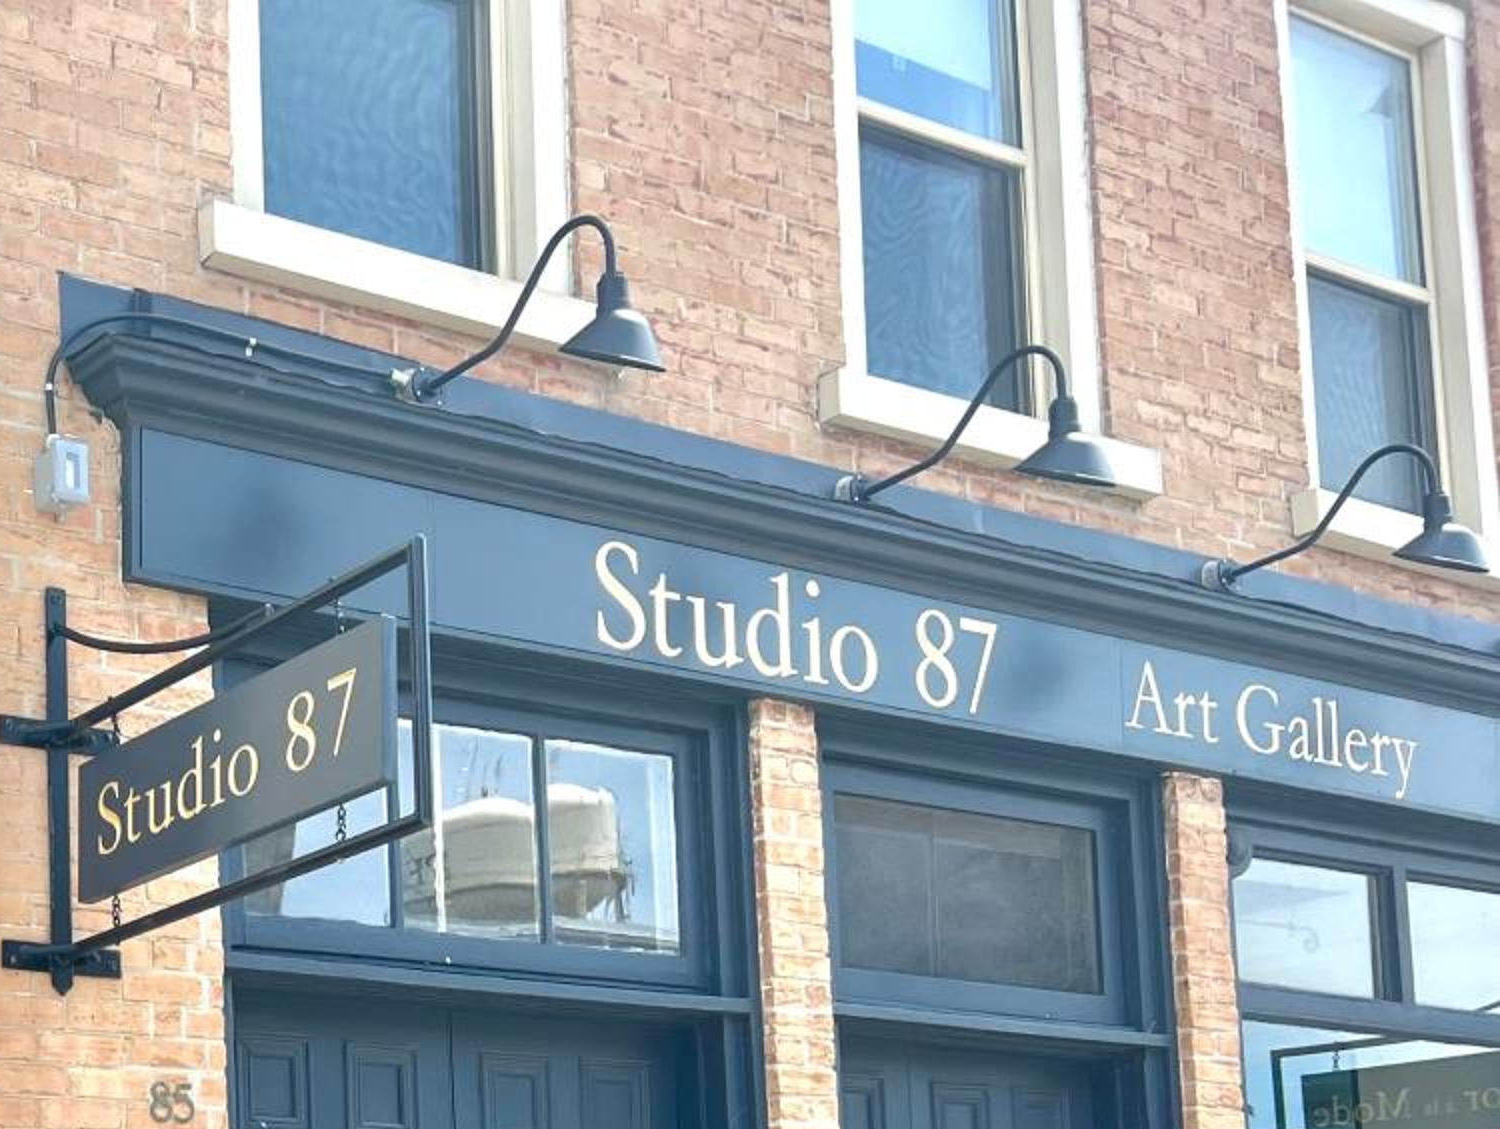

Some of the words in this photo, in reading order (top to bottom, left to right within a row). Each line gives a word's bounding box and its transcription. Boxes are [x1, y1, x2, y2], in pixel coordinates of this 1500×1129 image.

[595, 541, 880, 694] Studio
[914, 607, 998, 715] 87
[96, 728, 260, 857] Studio
[284, 667, 358, 773] 87
[1125, 660, 1219, 744] Art
[1235, 684, 1419, 800] Gallery
[149, 1081, 195, 1124] 85
